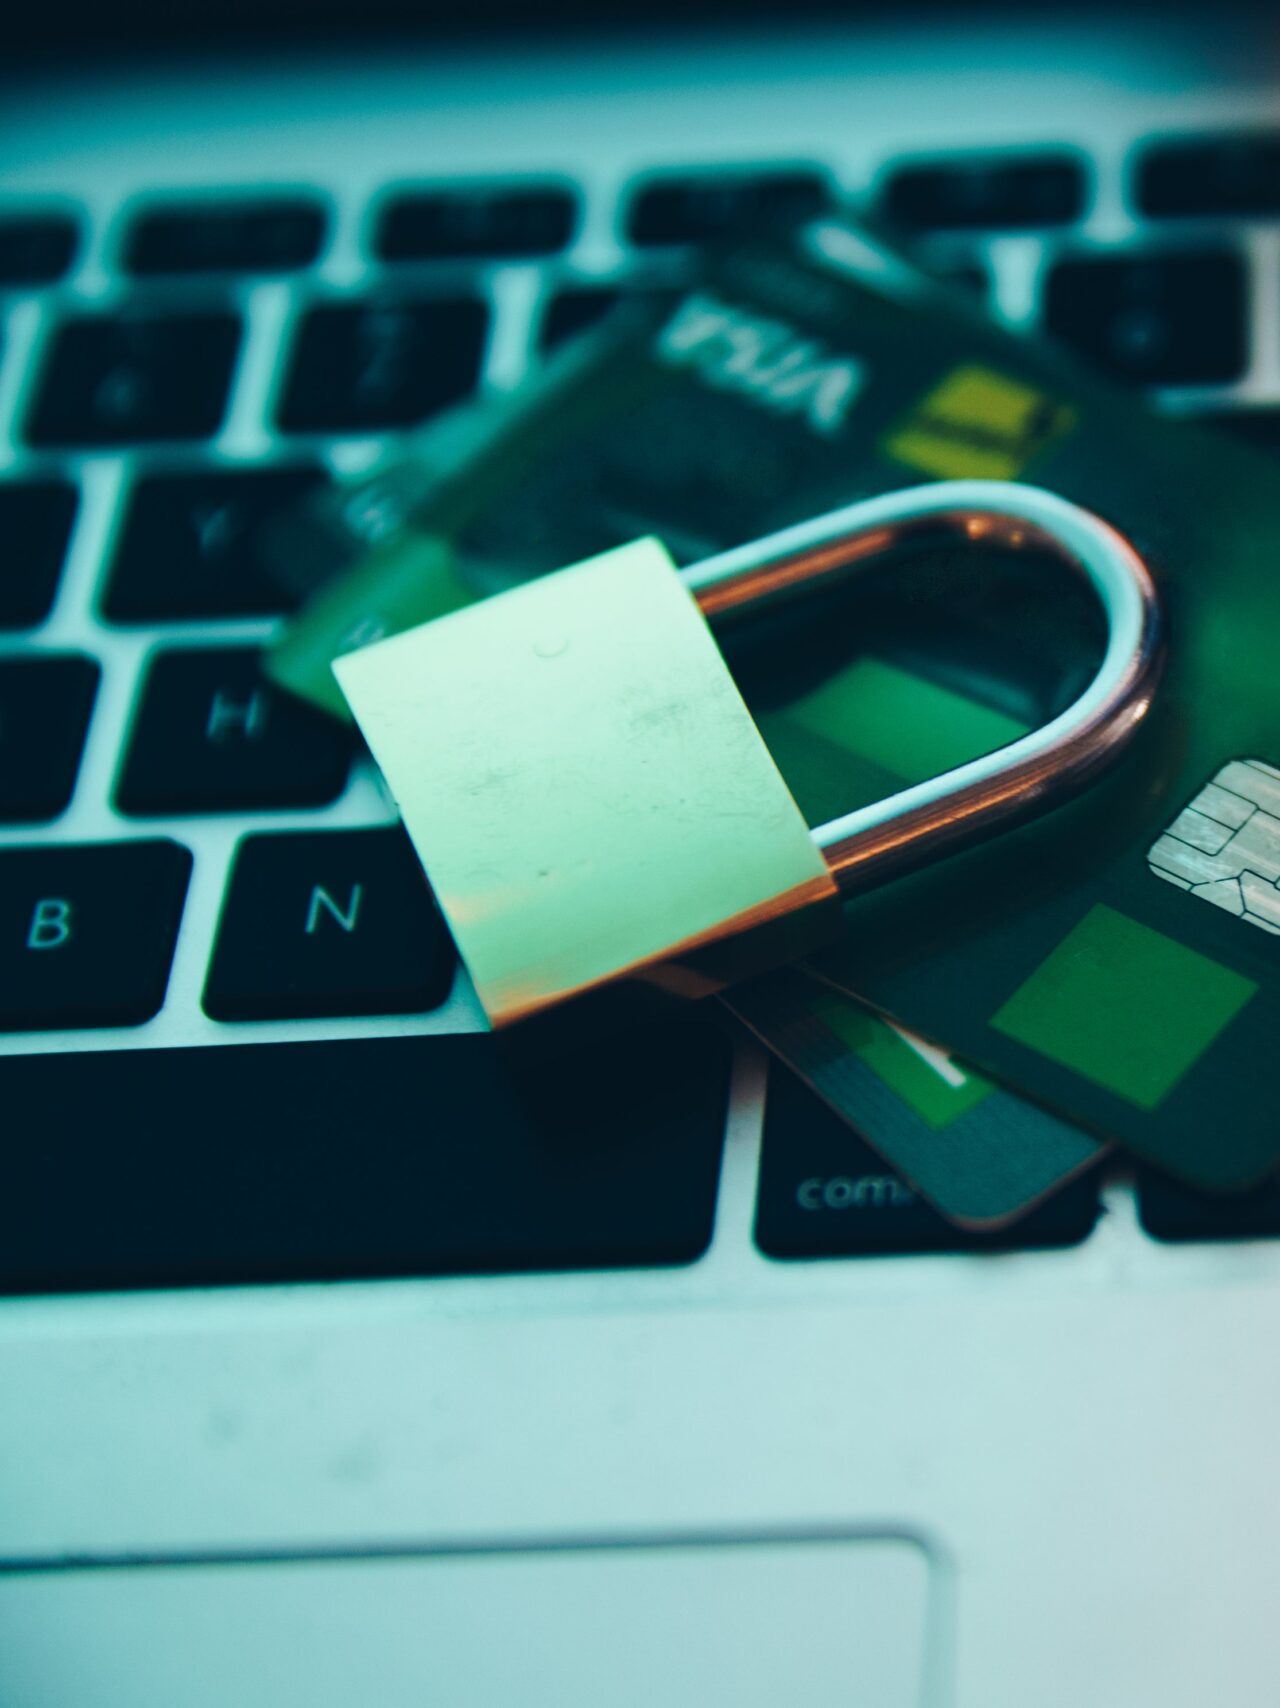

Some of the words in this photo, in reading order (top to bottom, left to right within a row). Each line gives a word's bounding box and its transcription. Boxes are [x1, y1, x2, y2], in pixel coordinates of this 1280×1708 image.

[206, 688, 262, 740] H
[27, 898, 71, 949] B
[304, 883, 361, 933] N
[797, 1174, 912, 1210] com
